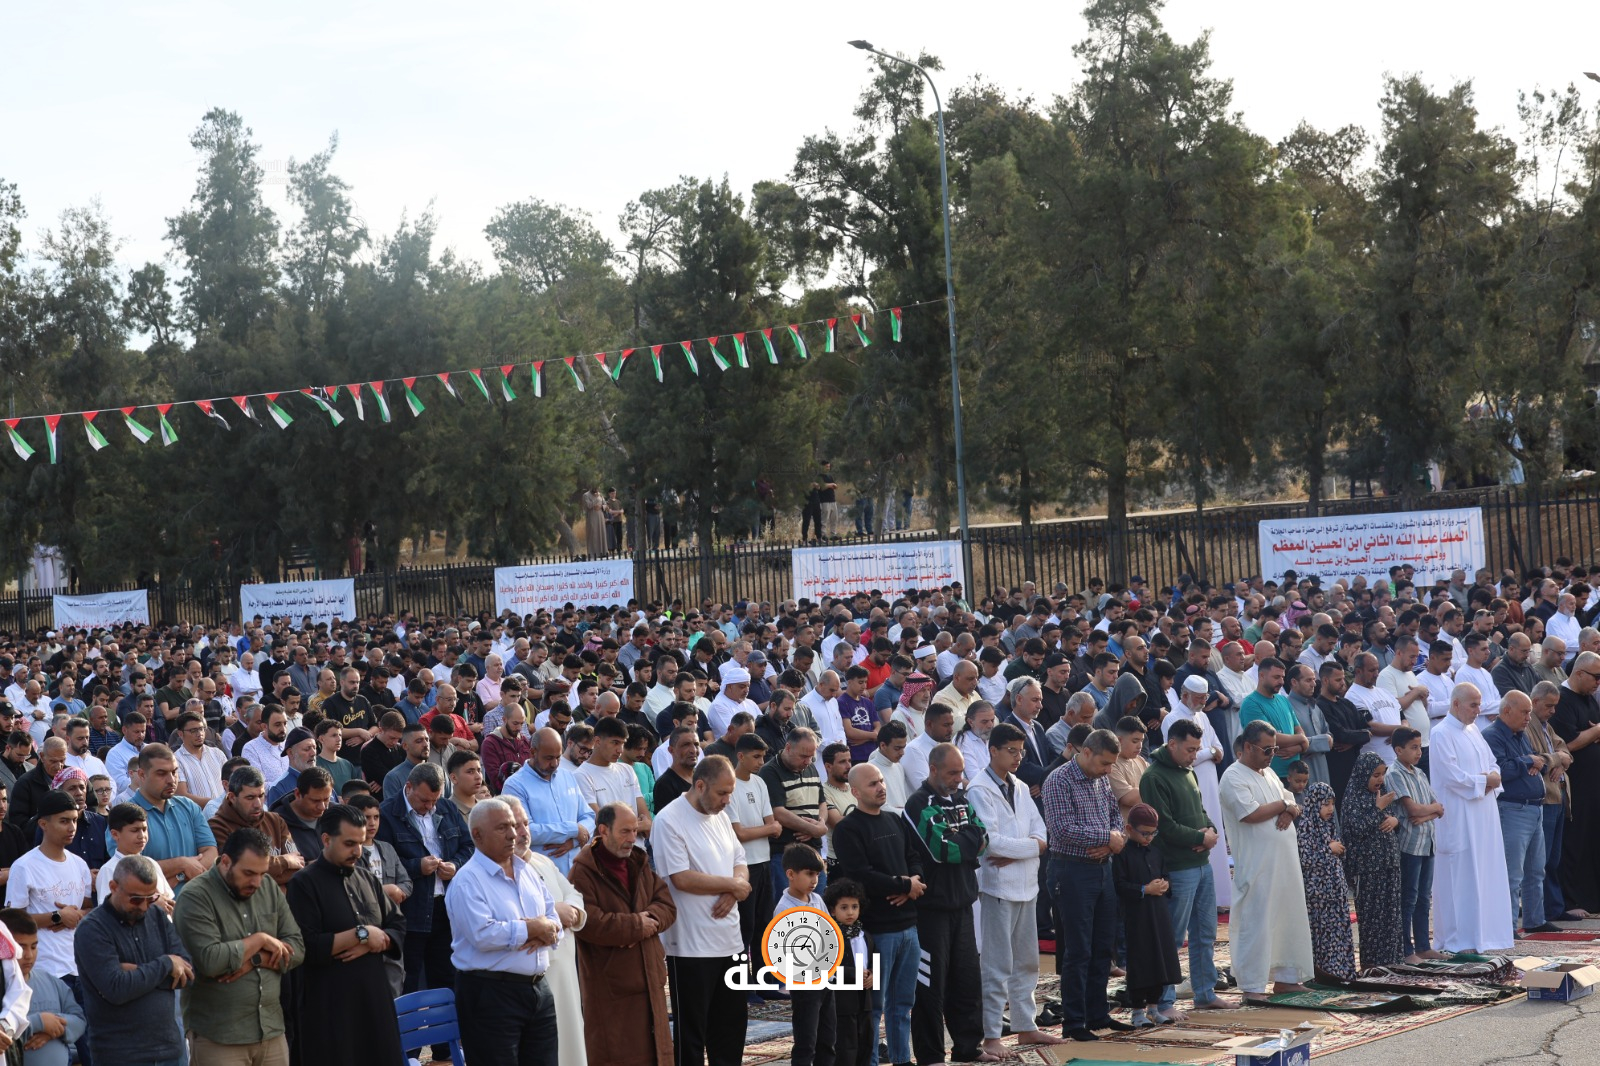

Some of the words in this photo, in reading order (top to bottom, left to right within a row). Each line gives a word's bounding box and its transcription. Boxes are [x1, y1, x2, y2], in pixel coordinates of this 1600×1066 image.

[1364, 533, 1393, 553] الثاني
[1396, 532, 1416, 545] الله
[1417, 532, 1438, 547] عبد
[1440, 530, 1468, 543] الملك
[1272, 538, 1308, 554] المعظم
[1309, 537, 1346, 553] الحسين
[1347, 536, 1362, 552] ابن
[1295, 557, 1314, 566] الله
[1316, 557, 1333, 567] عبد
[1335, 556, 1343, 566] بن
[1343, 555, 1371, 566] الحسين
[1372, 552, 1398, 564] الأمير
[1399, 552, 1422, 562] عهده
[1423, 550, 1446, 564] وولي
[342, 708, 366, 726] Chicago
